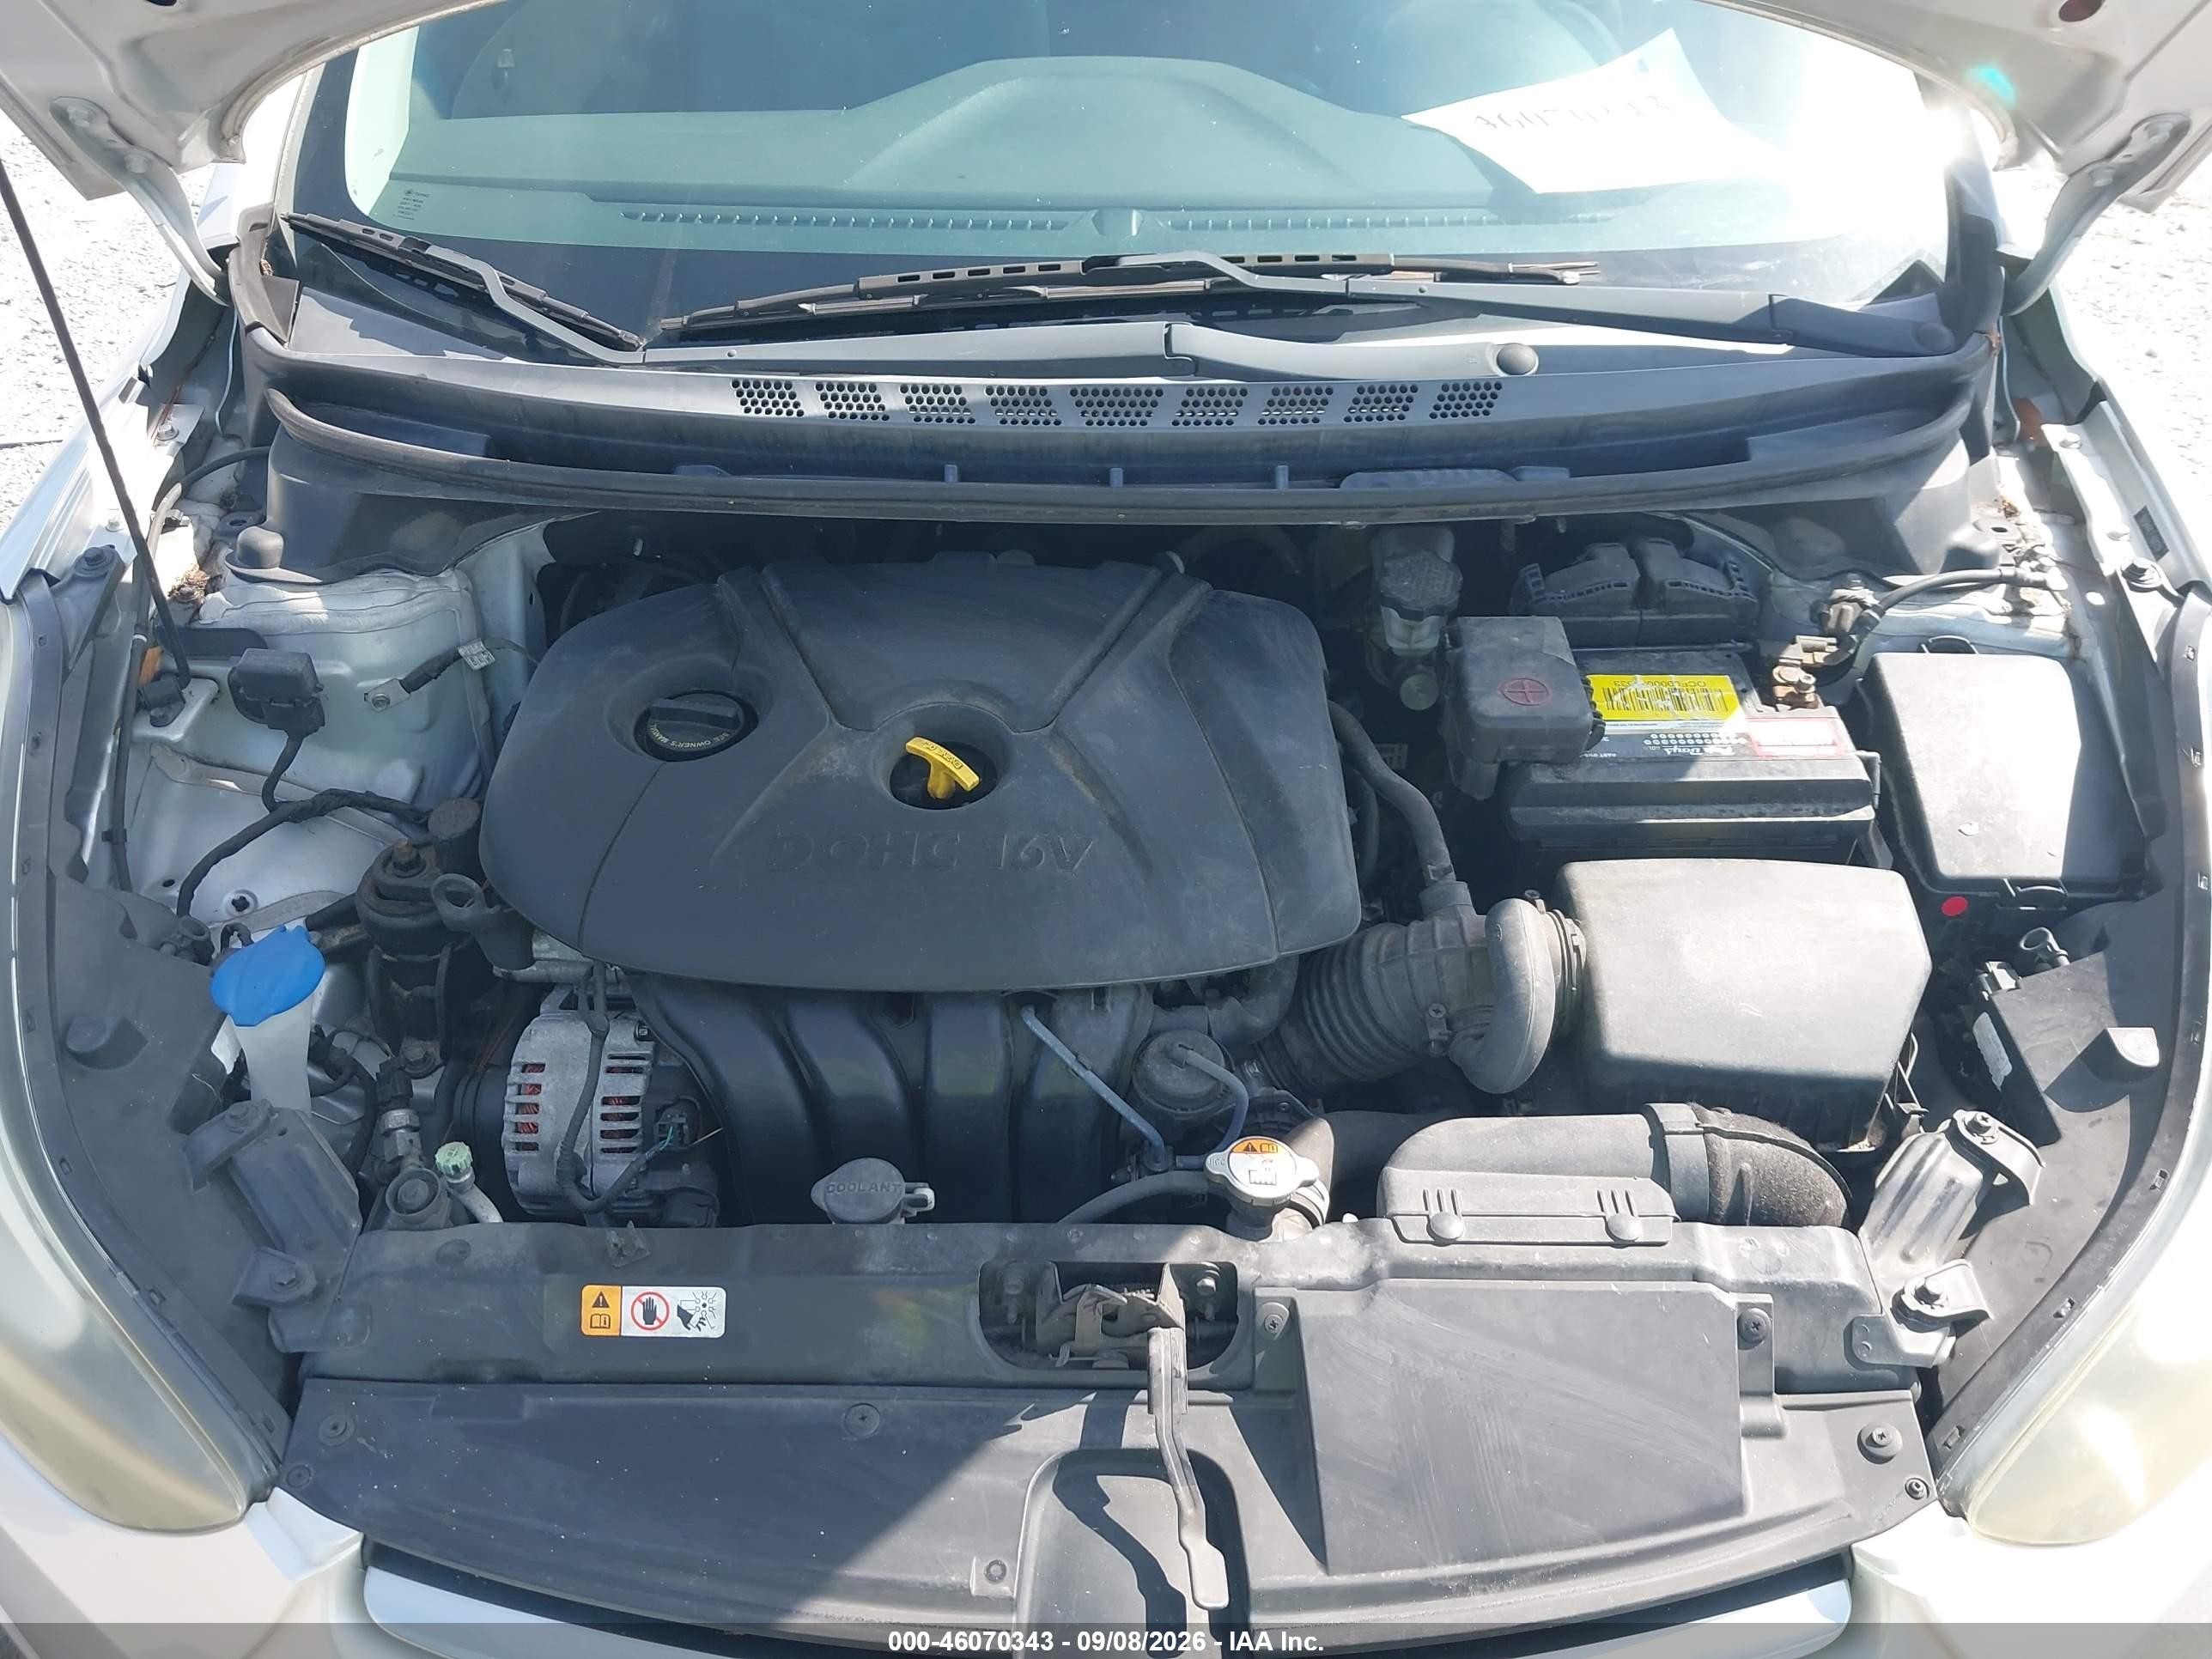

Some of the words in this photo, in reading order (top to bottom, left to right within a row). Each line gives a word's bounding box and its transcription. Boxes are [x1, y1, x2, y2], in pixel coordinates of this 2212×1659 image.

[649, 723, 670, 744] MANUAL
[713, 731, 730, 743] SEE
[671, 739, 712, 748] OWNER'S
[1663, 744, 1704, 756] Boys
[938, 749, 963, 770] ENGINE
[768, 830, 963, 872] DOHC
[988, 831, 1097, 874] 16V
[826, 1182, 901, 1194] COOLANT
